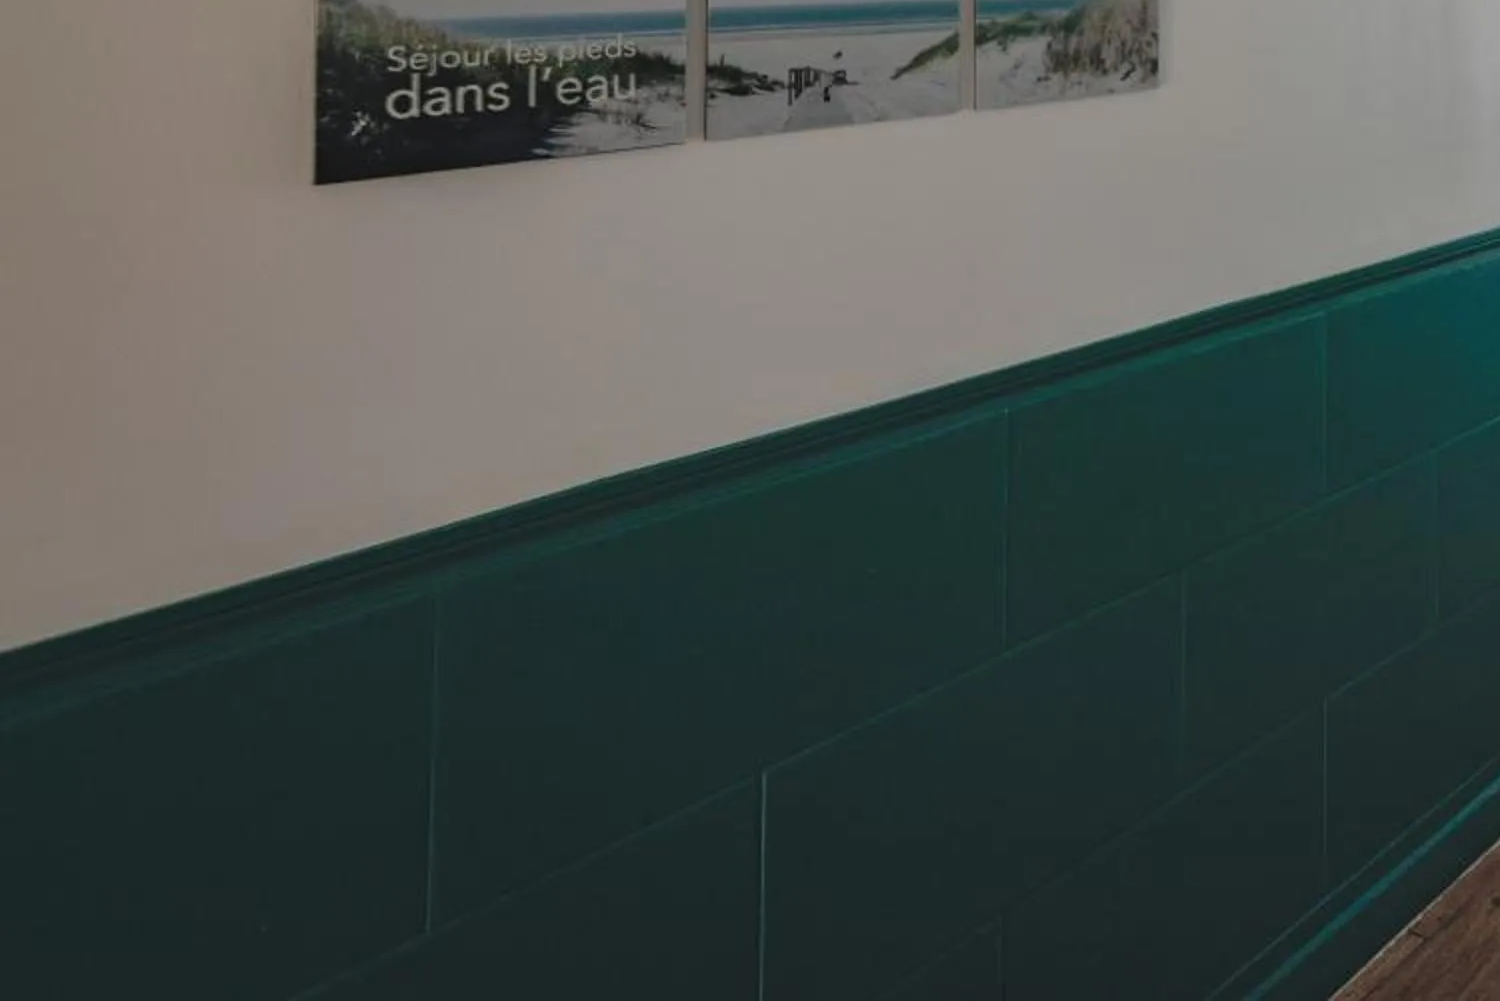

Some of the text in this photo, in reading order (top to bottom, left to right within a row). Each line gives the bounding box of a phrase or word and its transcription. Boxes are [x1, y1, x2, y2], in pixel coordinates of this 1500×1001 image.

[386, 32, 638, 77] Séjour les pieds
[384, 63, 637, 120] dans l'eau
